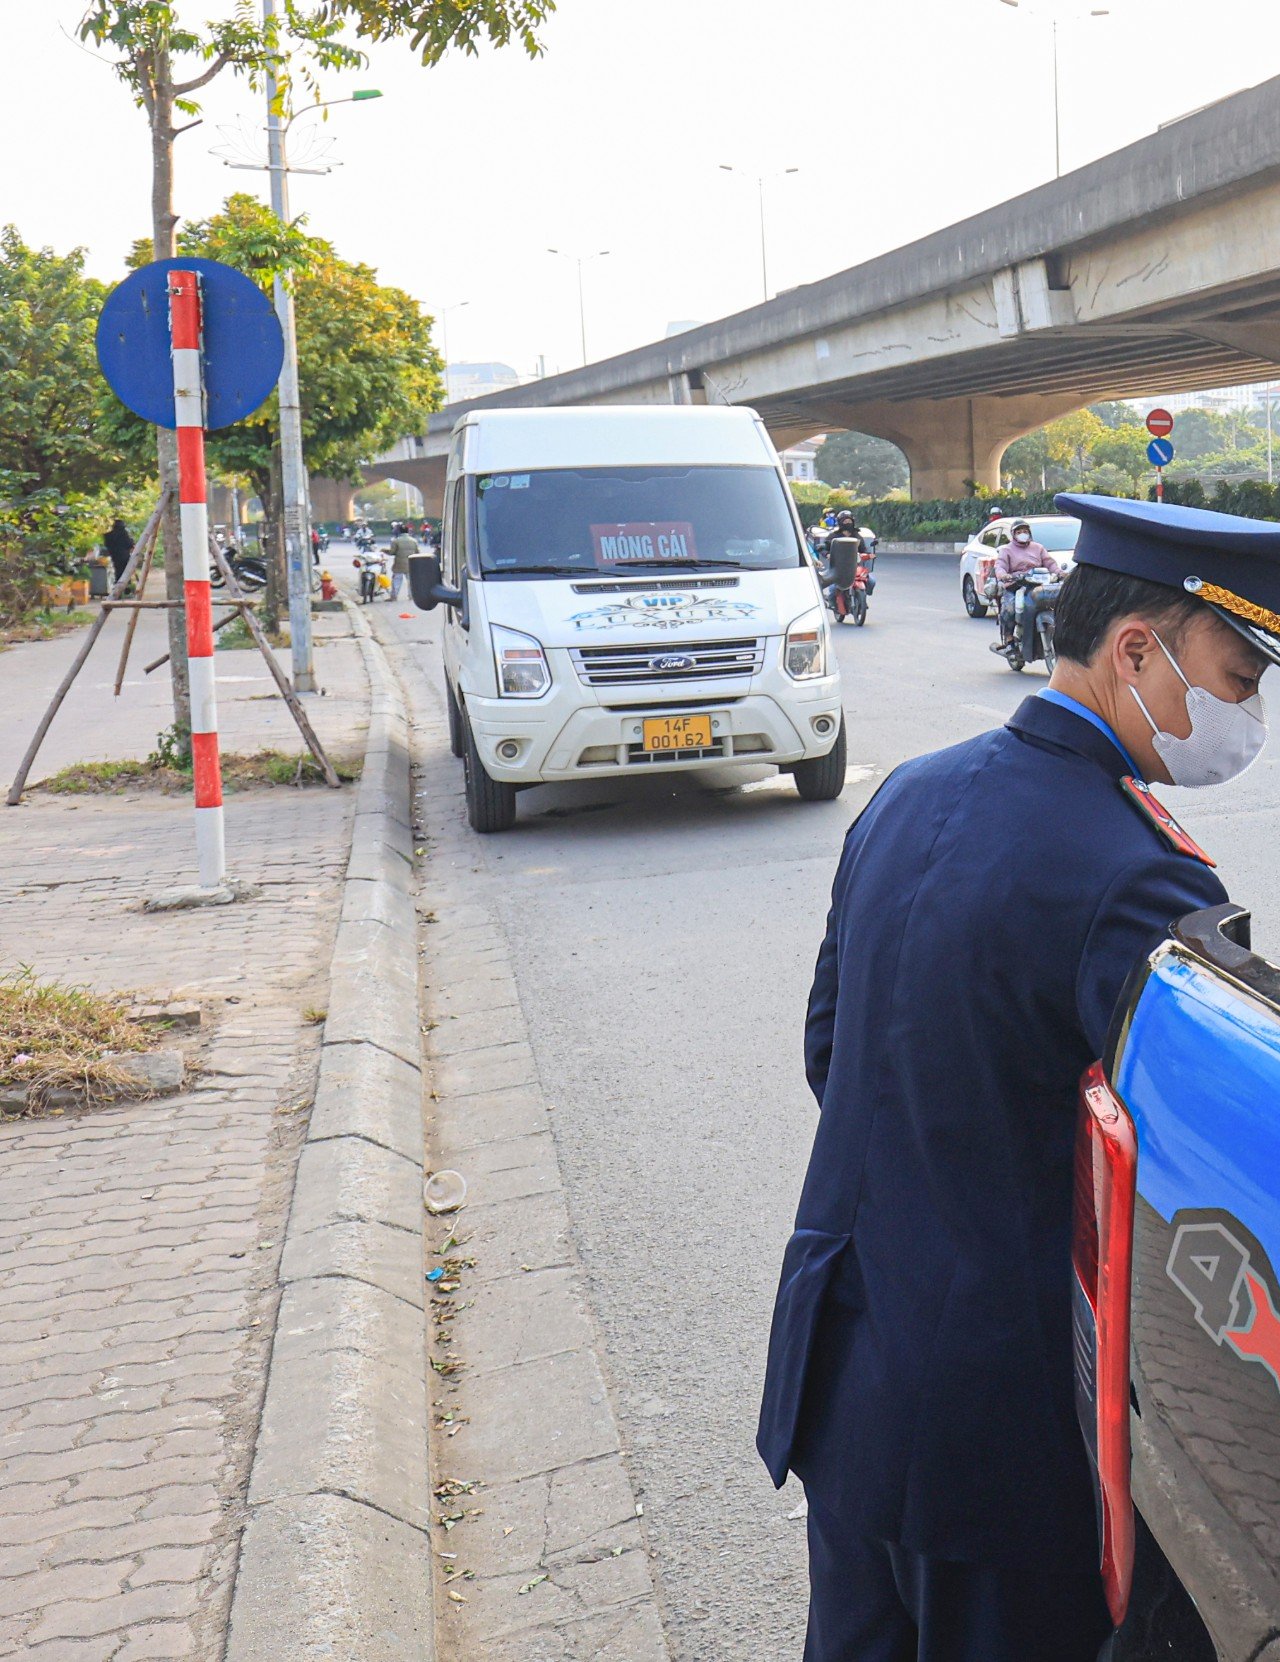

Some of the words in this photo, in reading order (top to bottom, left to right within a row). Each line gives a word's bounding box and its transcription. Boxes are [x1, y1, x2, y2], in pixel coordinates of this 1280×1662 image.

[600, 531, 655, 560] MÓNG
[657, 529, 688, 557] CÁI
[642, 597, 683, 607] VIP
[574, 609, 757, 628] LUXURY
[660, 657, 685, 669] Ford
[664, 718, 691, 733] 14F
[651, 732, 704, 749] 001.62
